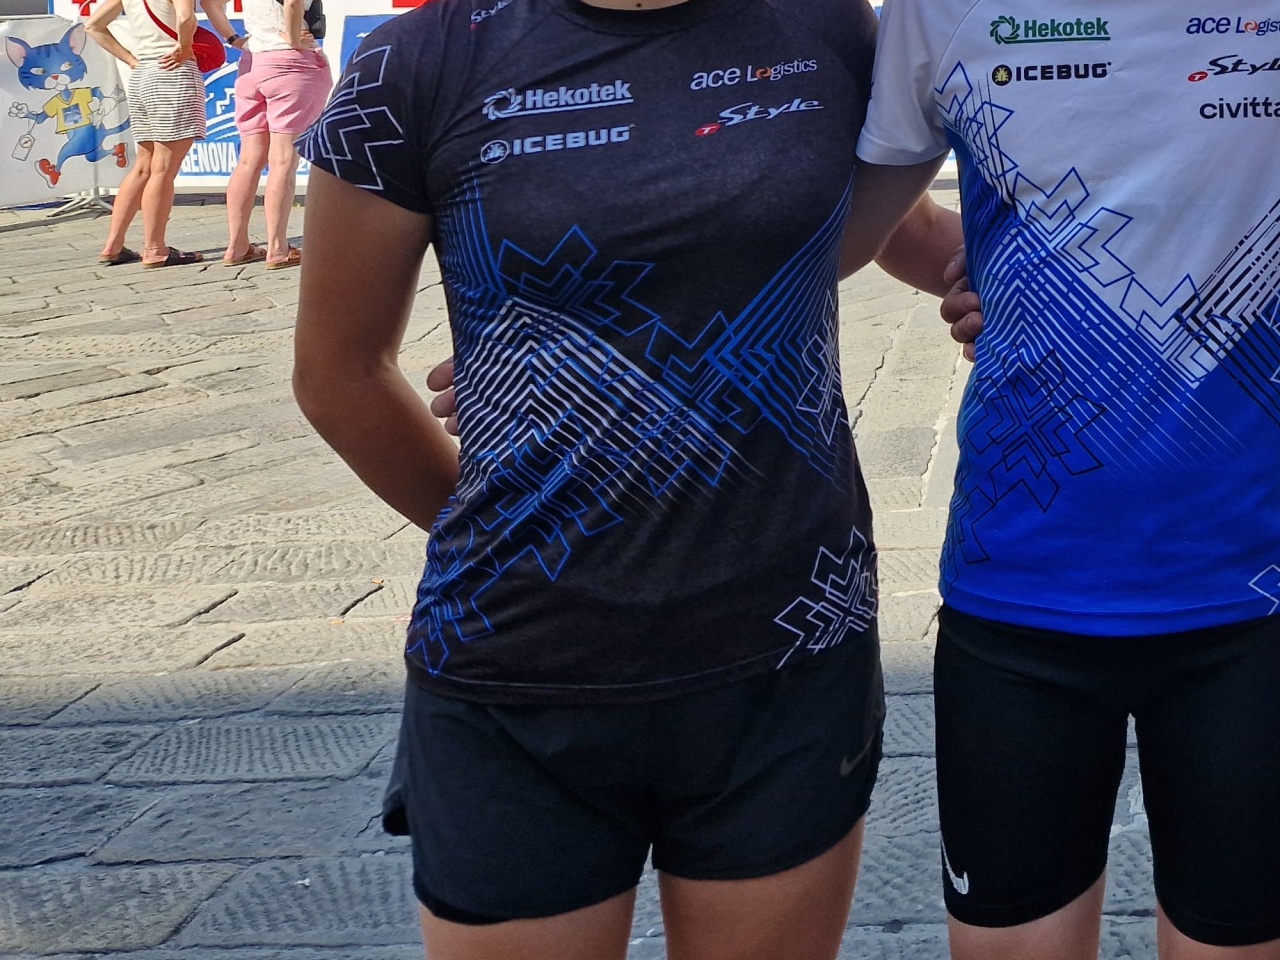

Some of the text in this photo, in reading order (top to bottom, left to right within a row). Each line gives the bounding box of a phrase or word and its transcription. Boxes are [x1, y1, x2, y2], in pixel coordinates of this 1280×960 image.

[1024, 17, 1109, 38] Hekotek
[1186, 16, 1231, 34] ace
[690, 58, 817, 90] ace Logistics
[1016, 62, 1108, 81] ICEBUG
[525, 80, 632, 109] Hekotek
[717, 98, 824, 126] Style
[512, 125, 631, 156] ICEBUG
